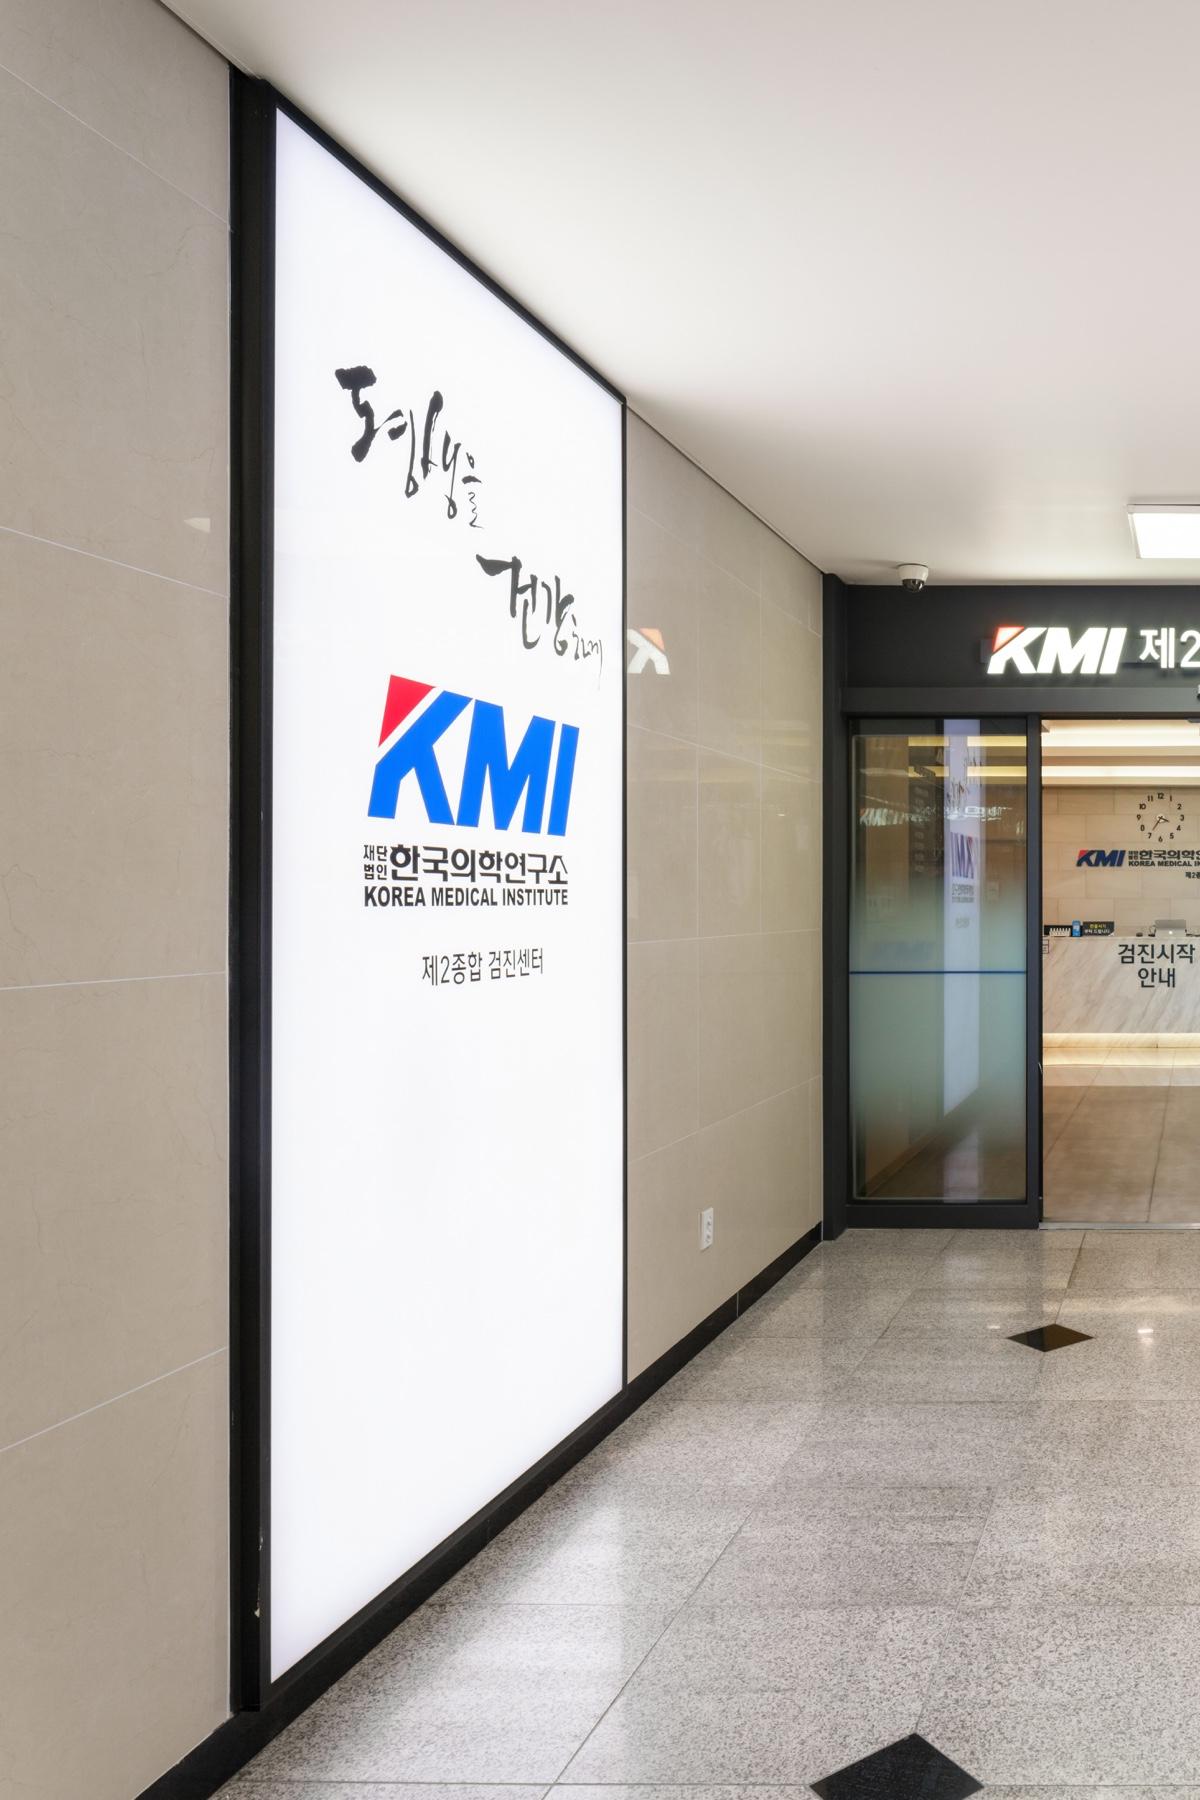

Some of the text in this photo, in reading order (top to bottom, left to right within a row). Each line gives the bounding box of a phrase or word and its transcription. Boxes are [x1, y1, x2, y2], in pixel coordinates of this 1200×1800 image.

[986, 626, 1127, 674] KMI
[368, 674, 580, 837] KMI
[1147, 794, 1153, 802] 11
[1157, 792, 1165, 800] 12
[1179, 814, 1185, 822] 3
[363, 844, 387, 861] 재단
[1076, 850, 1126, 867] KMI
[364, 864, 387, 880] 법인
[390, 844, 568, 884] 한국의학연구소
[364, 886, 568, 907] KOREA MEDICAL INSTITUTE
[1118, 944, 1195, 965] 검진시작
[422, 948, 543, 986] 제2종합 검진센터
[1137, 967, 1176, 988] 안내
